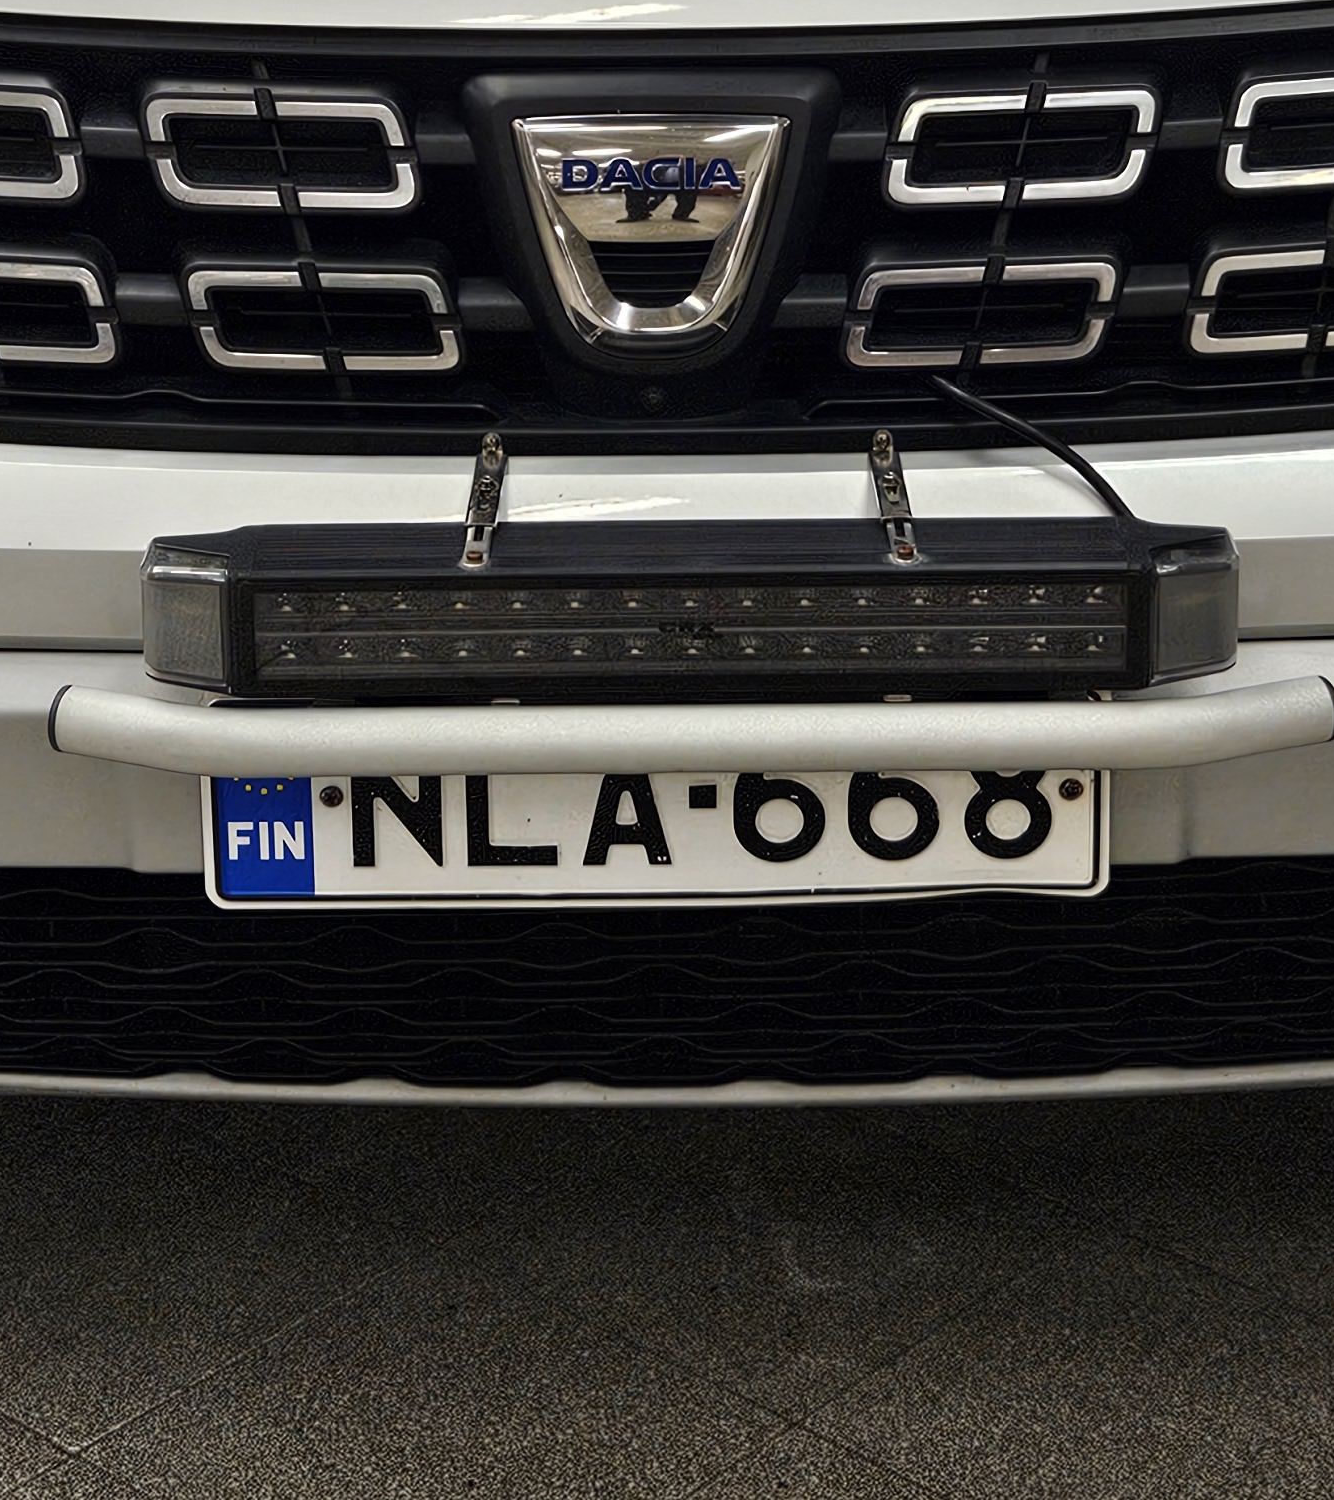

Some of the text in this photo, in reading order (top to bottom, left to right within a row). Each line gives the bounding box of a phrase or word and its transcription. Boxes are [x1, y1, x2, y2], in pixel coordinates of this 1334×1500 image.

[560, 157, 742, 191] DACIA
[351, 771, 1053, 867] NLA-668
[227, 821, 306, 860] FIN
